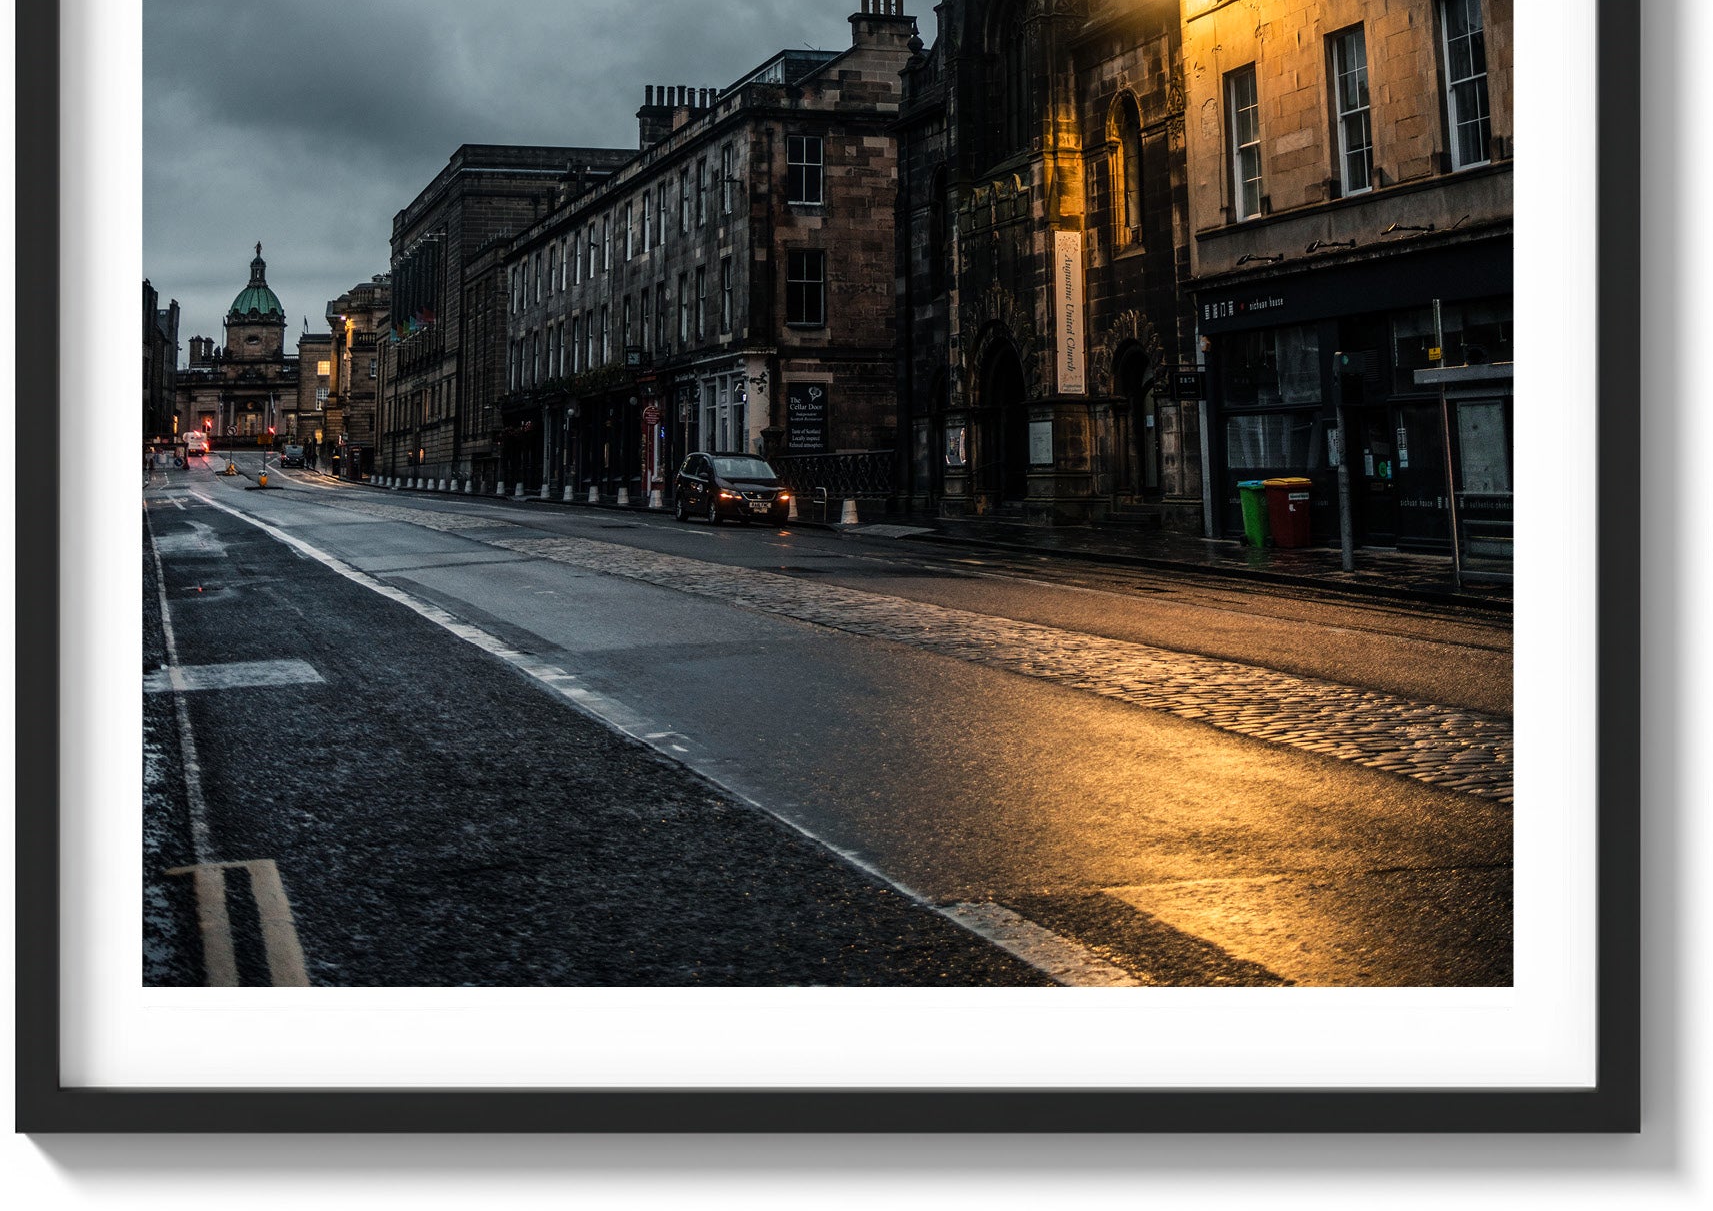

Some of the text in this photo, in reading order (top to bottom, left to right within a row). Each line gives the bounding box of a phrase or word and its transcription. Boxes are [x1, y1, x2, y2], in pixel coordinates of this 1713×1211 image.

[1062, 254, 1075, 301] Augustine
[1065, 303, 1075, 335] United
[1249, 295, 1284, 311] sichuan house
[1066, 337, 1077, 372] Church
